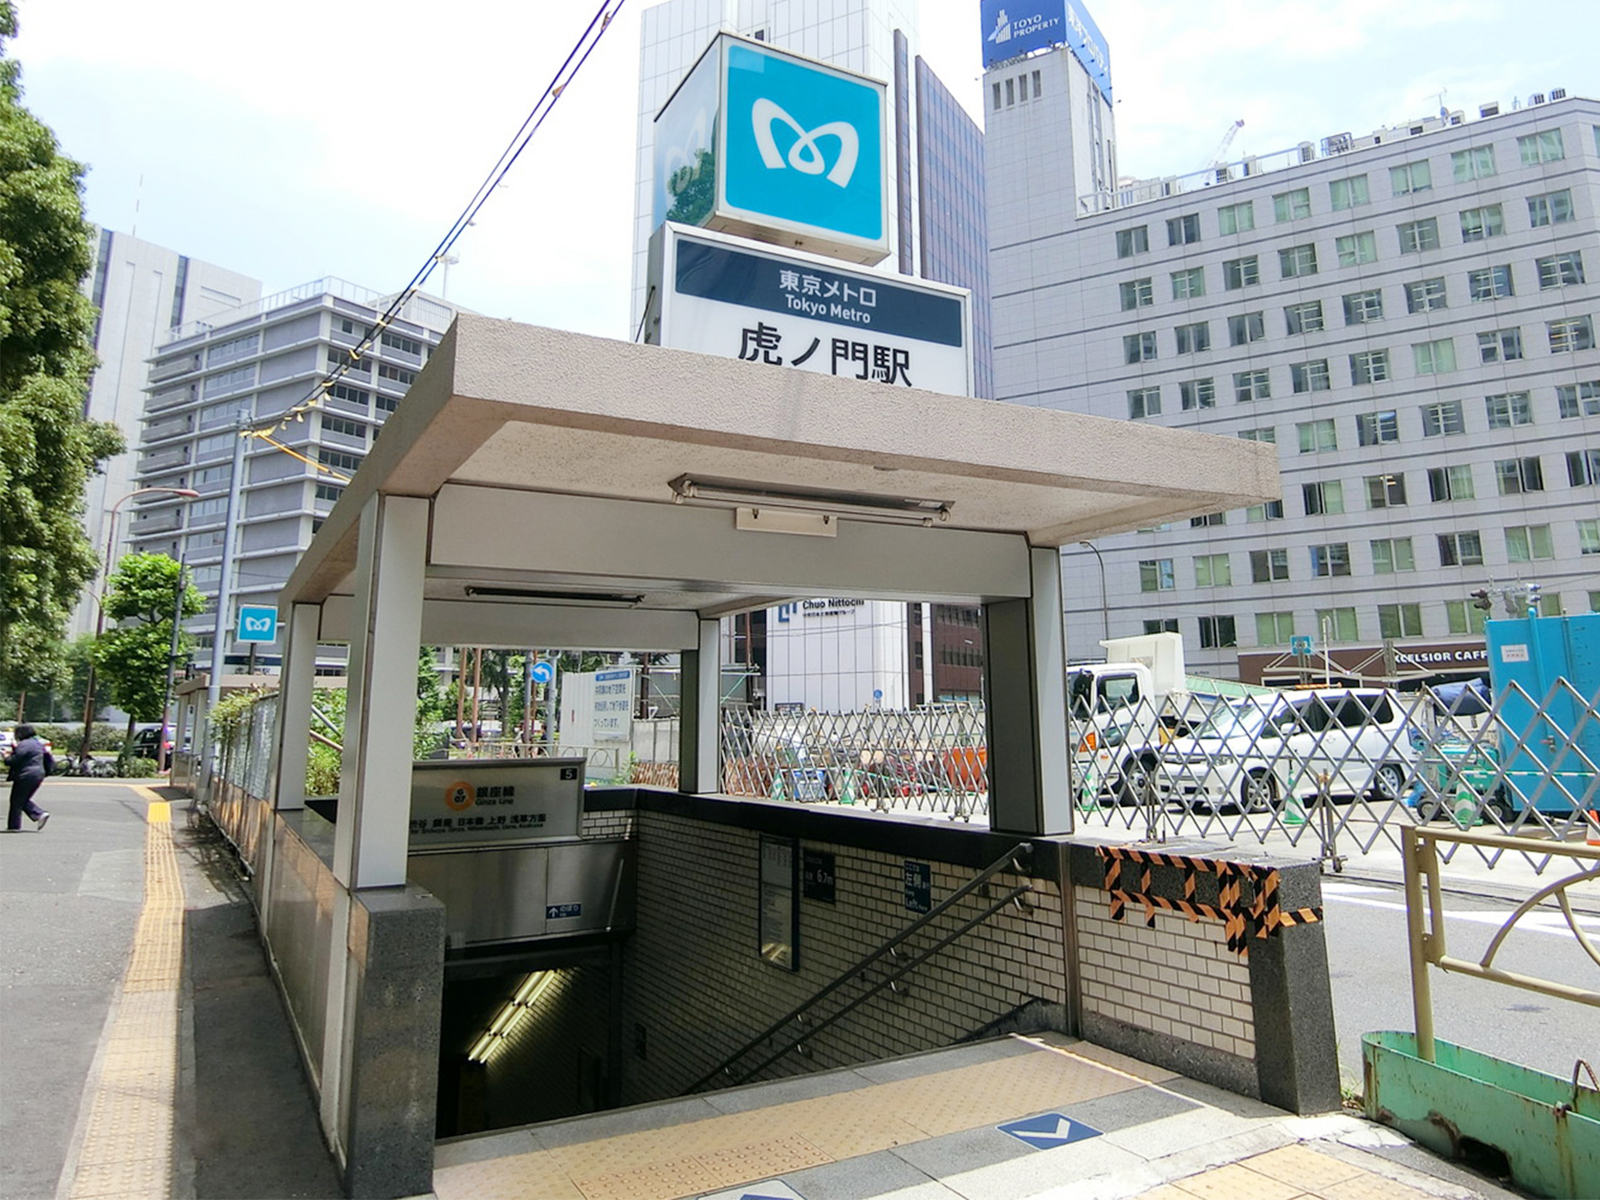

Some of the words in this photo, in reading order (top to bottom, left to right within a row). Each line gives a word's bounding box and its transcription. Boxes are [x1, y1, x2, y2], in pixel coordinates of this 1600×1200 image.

[1013, 14, 1042, 30] TOYO
[1013, 17, 1060, 38] PROPERTY
[779, 269, 877, 308] 東京メトロ
[785, 293, 827, 317] Tokyo
[830, 302, 872, 324] Metro
[738, 321, 913, 388] 虎ノ門駅
[802, 599, 826, 610] Chuo
[564, 769, 573, 780] 5
[476, 786, 515, 799] 銀座線
[453, 796, 467, 804] 07
[475, 798, 497, 806] Ginza
